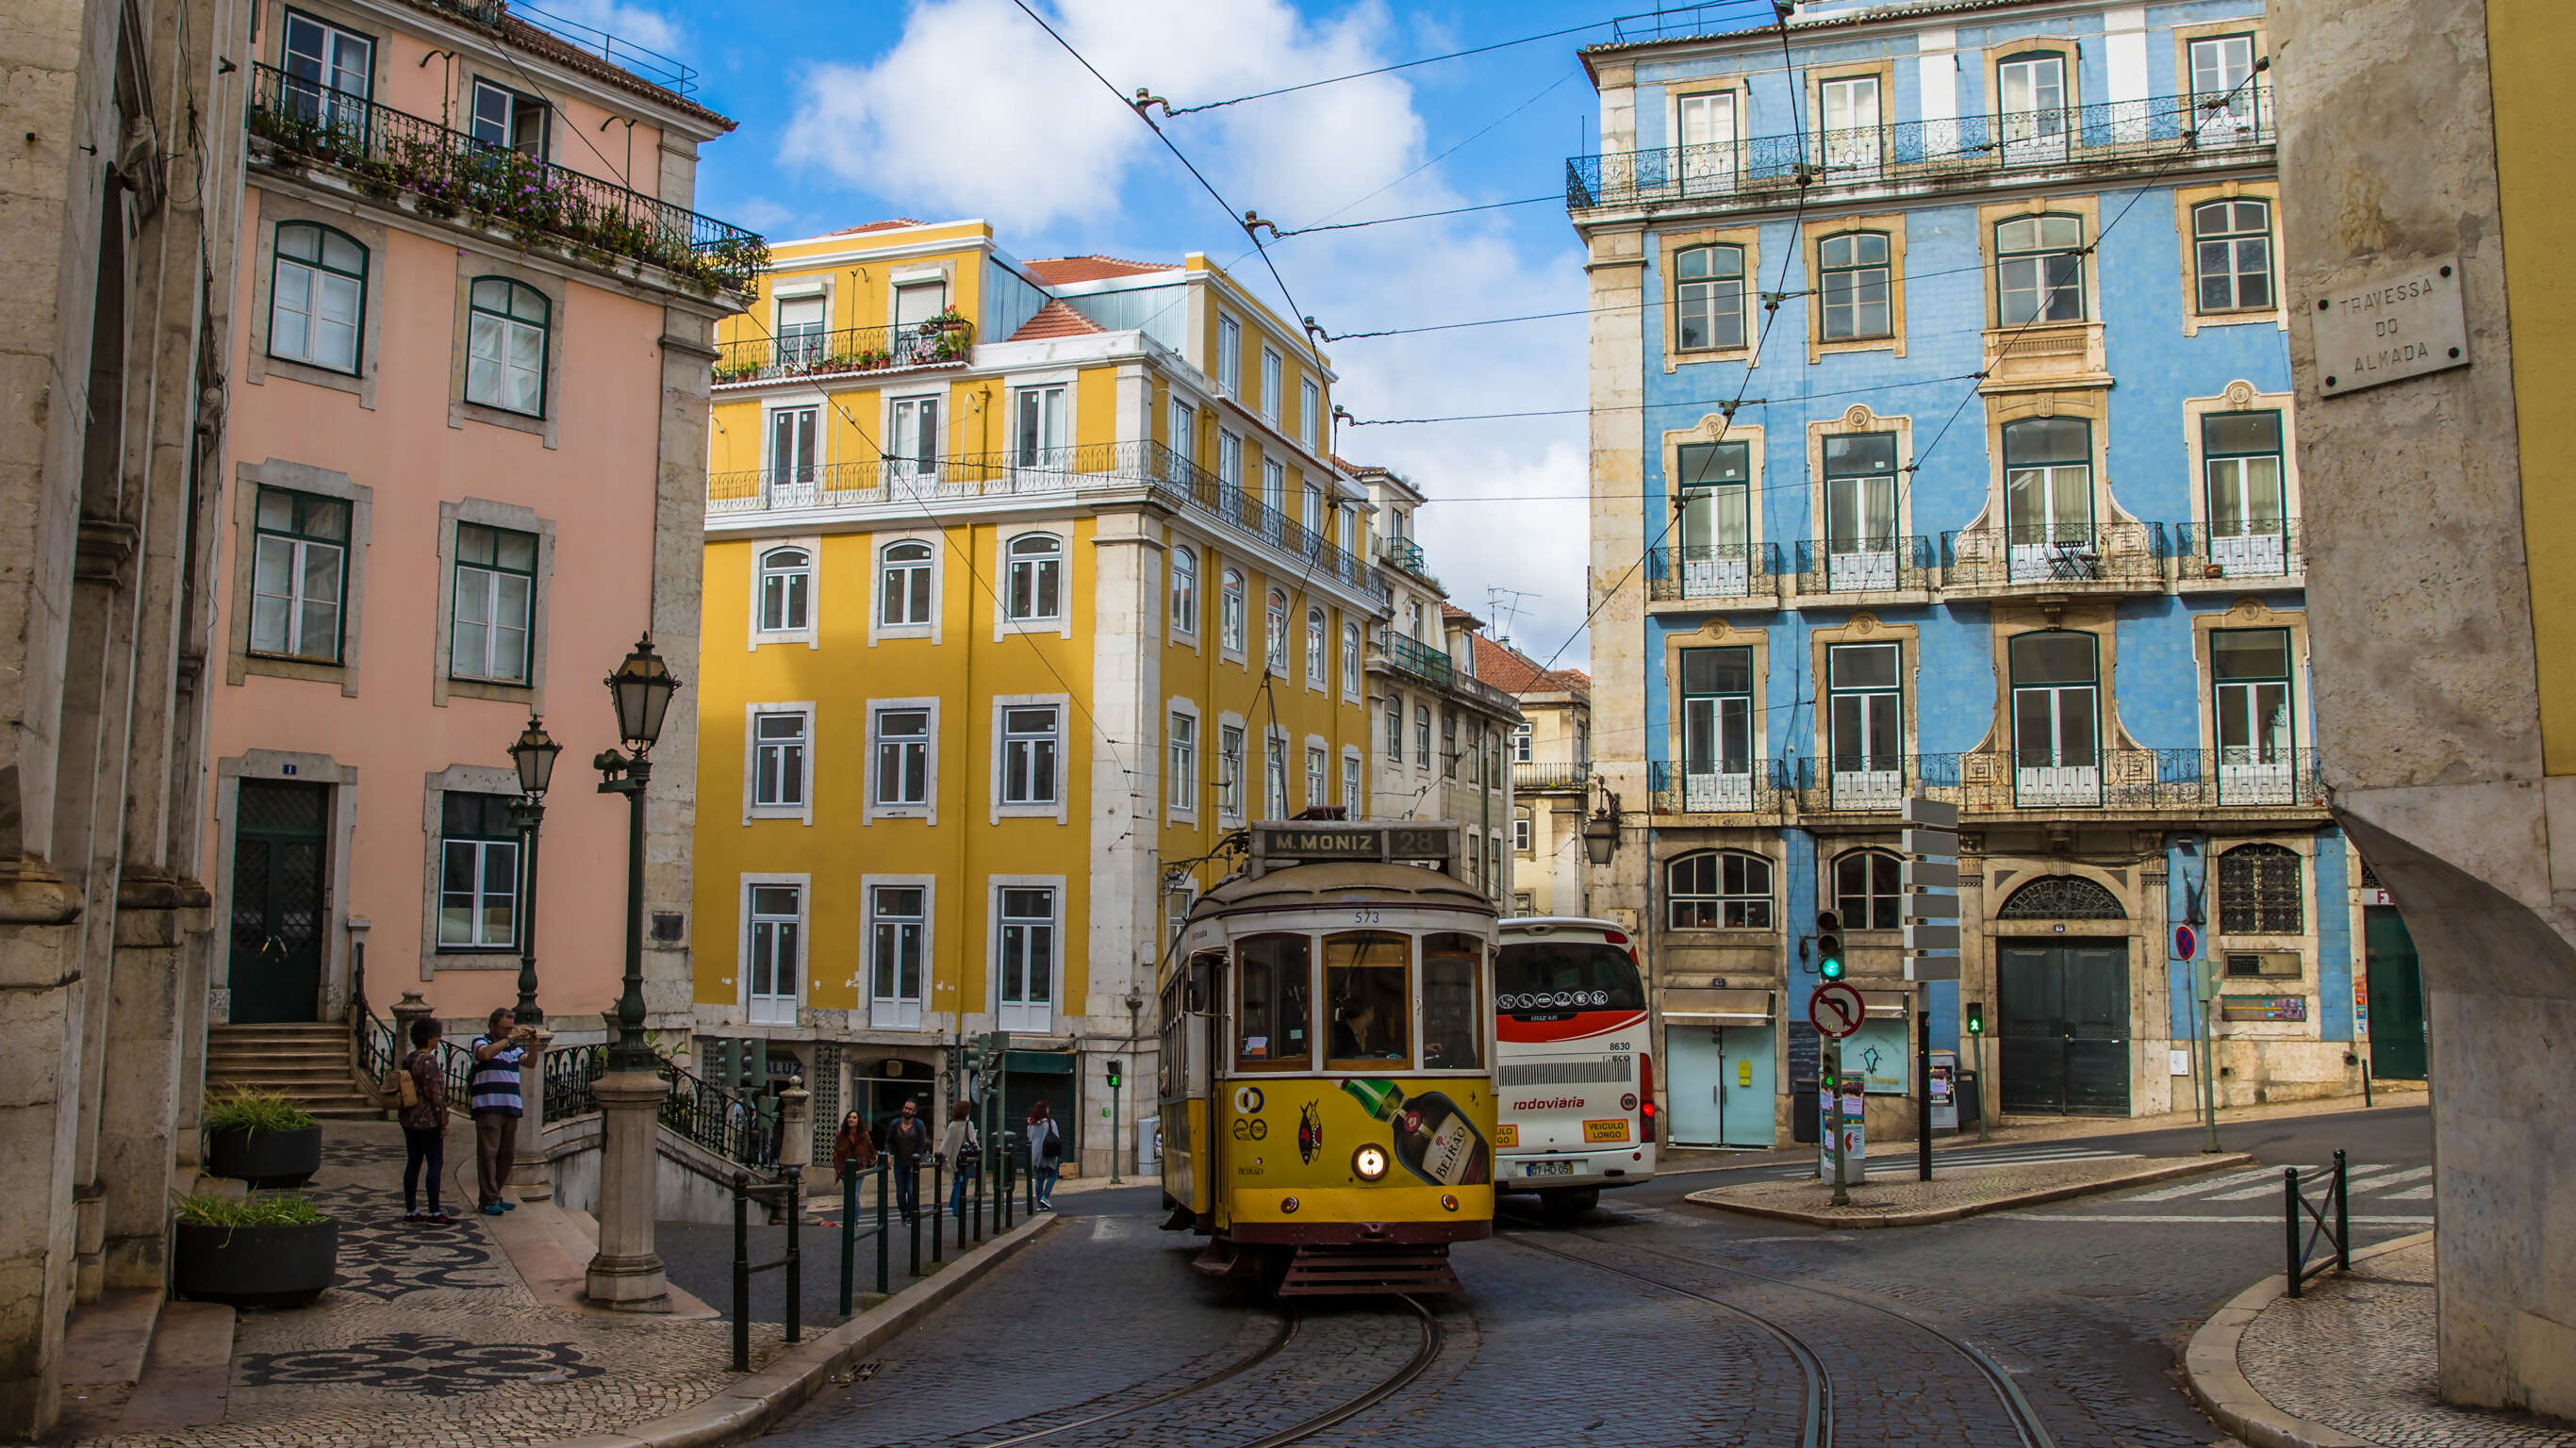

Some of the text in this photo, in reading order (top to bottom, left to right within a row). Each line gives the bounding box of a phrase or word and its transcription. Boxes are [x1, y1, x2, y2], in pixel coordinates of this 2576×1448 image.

[2339, 278, 2433, 316] TRAVESSA
[2375, 318, 2399, 337] DO
[2353, 341, 2429, 372] ALMADA
[1399, 831, 1434, 852] 28
[1355, 912, 1380, 924] 573
[1609, 1042, 1631, 1051] 8630
[1512, 1095, 1585, 1111] rodoviária
[1588, 1122, 1625, 1130] VEICULO
